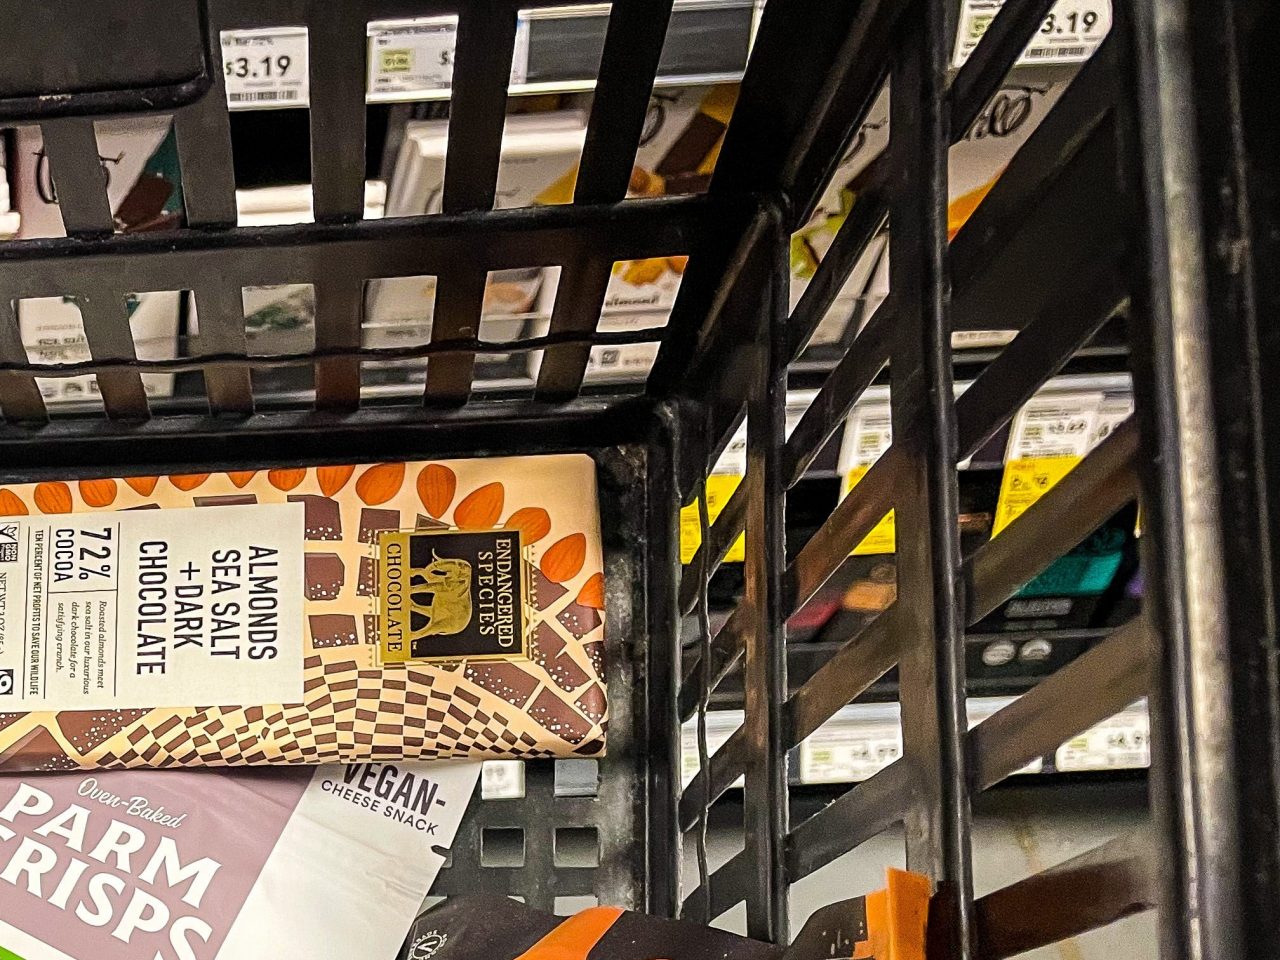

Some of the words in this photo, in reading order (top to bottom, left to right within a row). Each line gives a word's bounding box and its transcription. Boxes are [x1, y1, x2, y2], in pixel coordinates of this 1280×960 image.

[35, 529, 44, 542] TEN
[34, 543, 44, 571] PERCENT
[54, 528, 75, 583] COCOA
[79, 527, 112, 580] 72%
[32, 582, 42, 594] NET
[33, 572, 43, 581] OF
[211, 549, 241, 595] SEA
[31, 594, 42, 622] PROFITS
[71, 601, 80, 620] dark
[136, 540, 169, 676] CHOCOLATE
[247, 545, 279, 661] ALMONDS
[385, 543, 403, 653] CHOCOLATE
[477, 551, 496, 636] SPECIES
[495, 538, 515, 648] ENDANGERED
[31, 622, 41, 632] TO
[55, 602, 66, 642] satisfying
[84, 615, 93, 631] salt
[98, 600, 107, 633] Roasted
[210, 602, 241, 660] SALT
[31, 632, 40, 649] SAVE
[70, 621, 79, 659] chocolate
[84, 631, 93, 640] in
[97, 633, 106, 668] almonds
[30, 649, 40, 664] OUR
[68, 658, 78, 672] for
[29, 664, 39, 696] WILDLIFE
[83, 656, 93, 695] luxurious
[97, 668, 105, 689] meet
[77, 777, 187, 829] Oven-Baked
[343, 762, 447, 817] VEGAN-
[320, 779, 381, 812] CHEESE
[383, 805, 439, 836] SNACK
